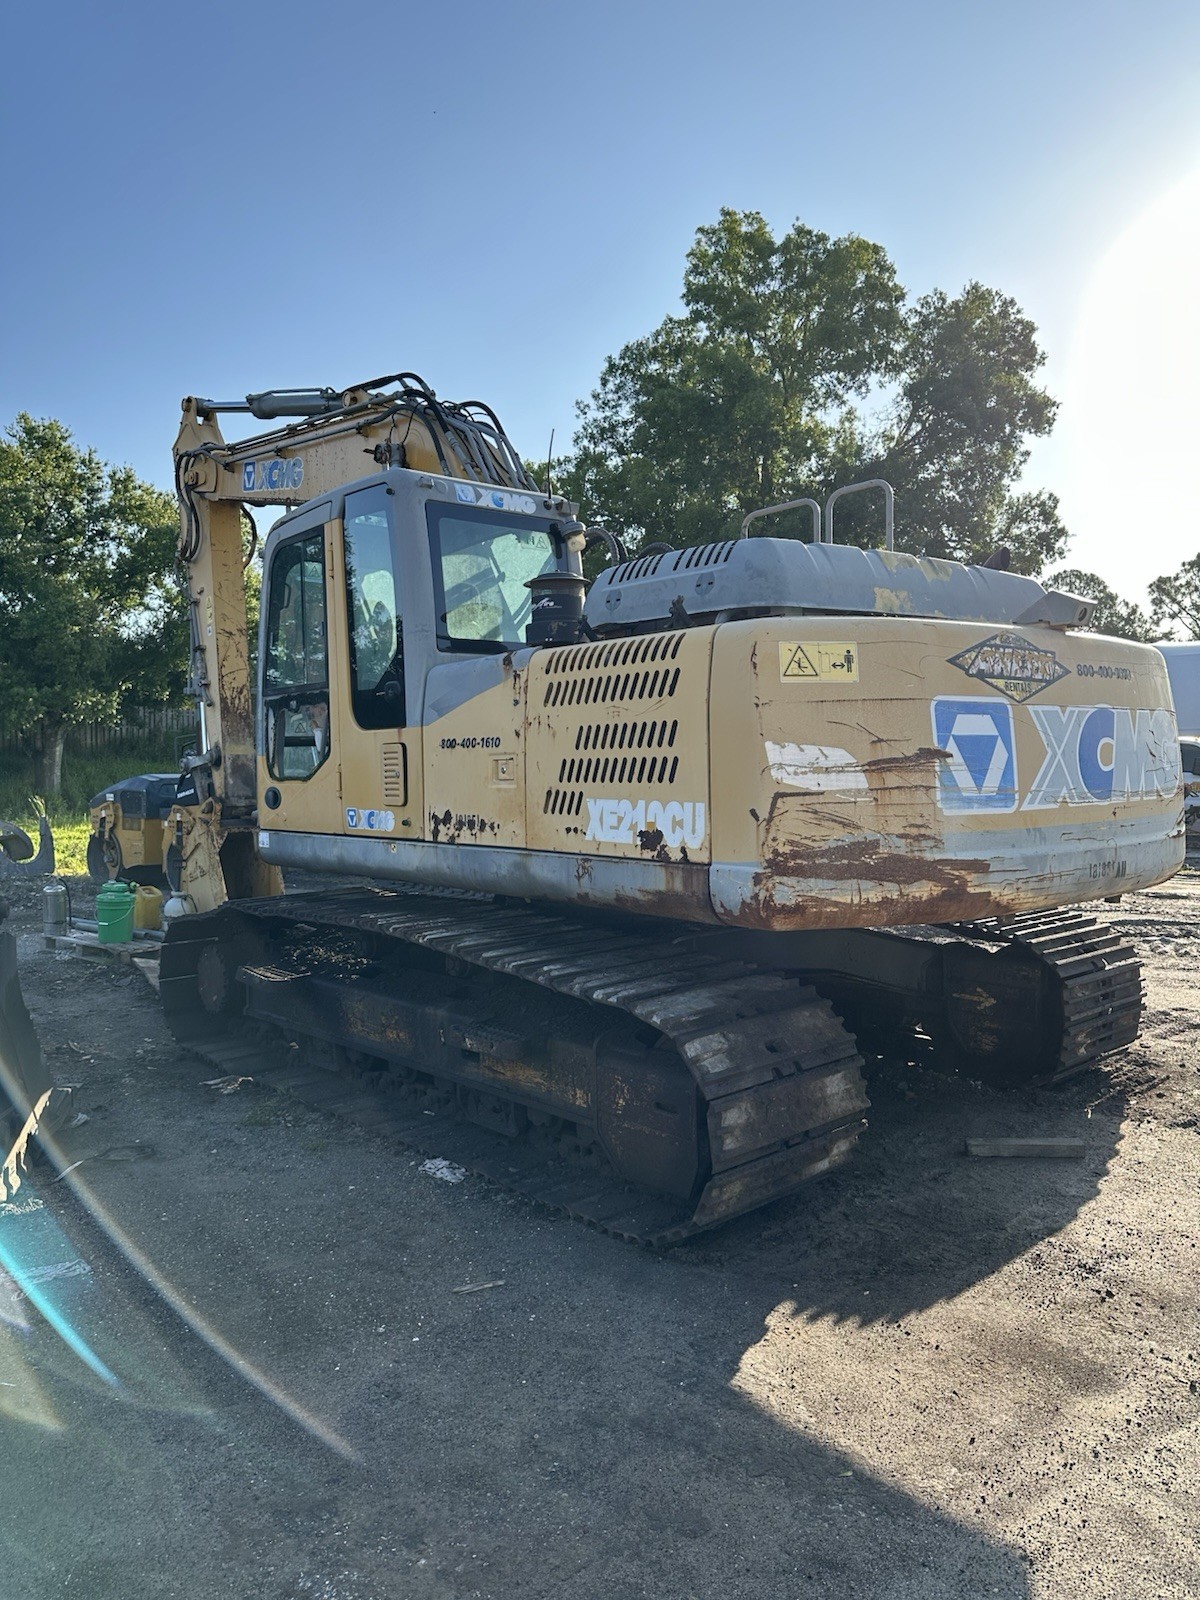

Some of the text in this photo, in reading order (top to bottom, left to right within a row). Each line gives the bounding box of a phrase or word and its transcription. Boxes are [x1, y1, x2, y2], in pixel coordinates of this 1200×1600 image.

[255, 456, 305, 491] XCMG
[476, 487, 537, 514] XCMG
[440, 736, 501, 749] 800-400-1610
[1020, 703, 1180, 811] XCMG
[358, 809, 396, 833] XCMG
